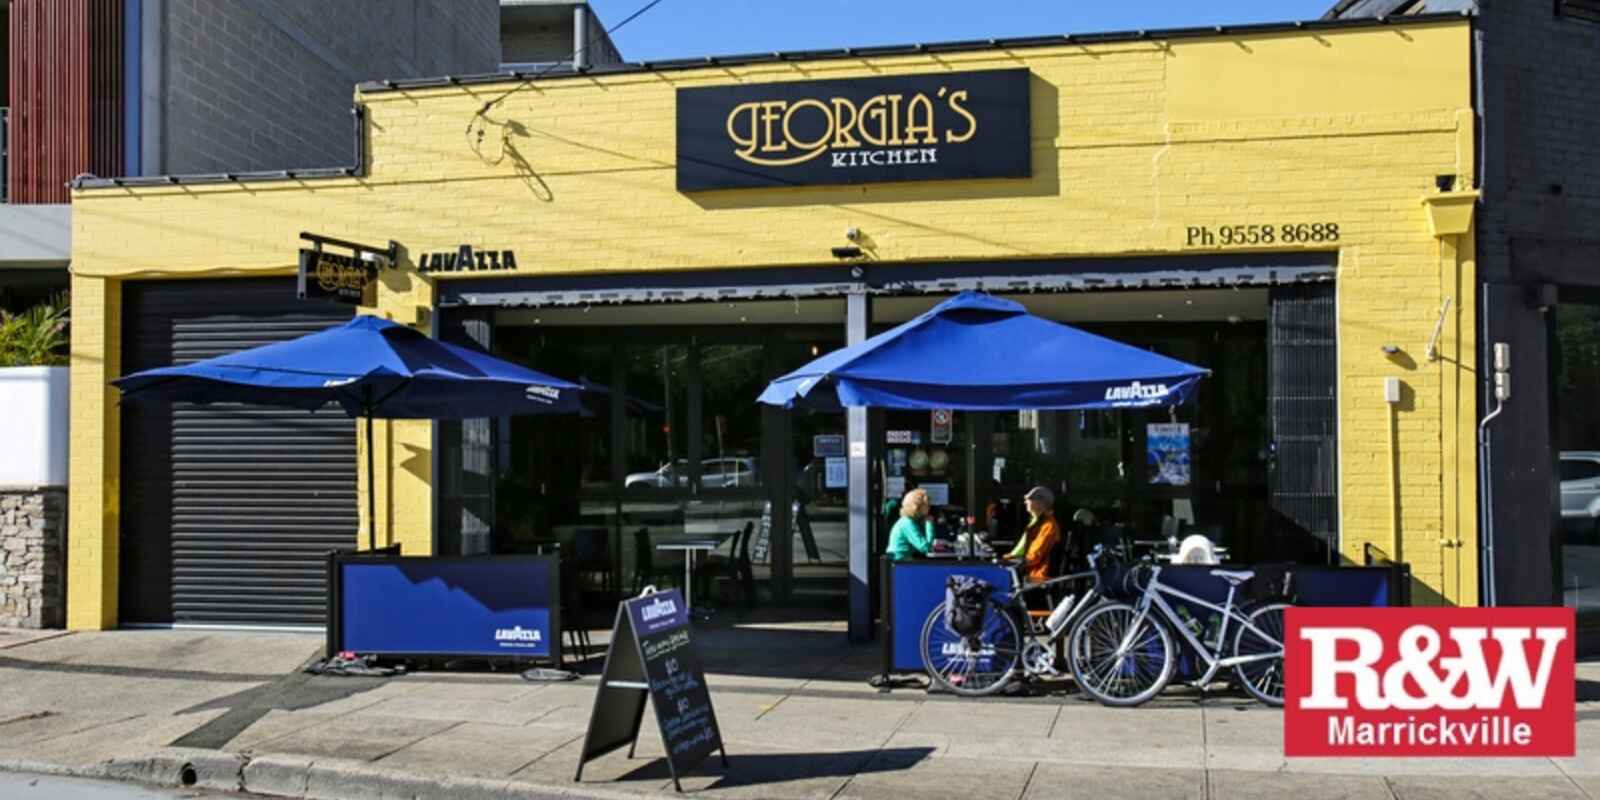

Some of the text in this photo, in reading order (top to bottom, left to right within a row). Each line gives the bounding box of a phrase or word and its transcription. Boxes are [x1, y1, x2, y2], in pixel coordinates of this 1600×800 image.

[726, 86, 977, 166] GEORGIA'S
[831, 148, 938, 168] KITCHEN
[1186, 222, 1340, 246] Ph 9558 8688
[418, 244, 517, 272] LAVAZZA
[1104, 380, 1169, 401] LAVAZZA
[495, 625, 542, 641] LAVAZZA
